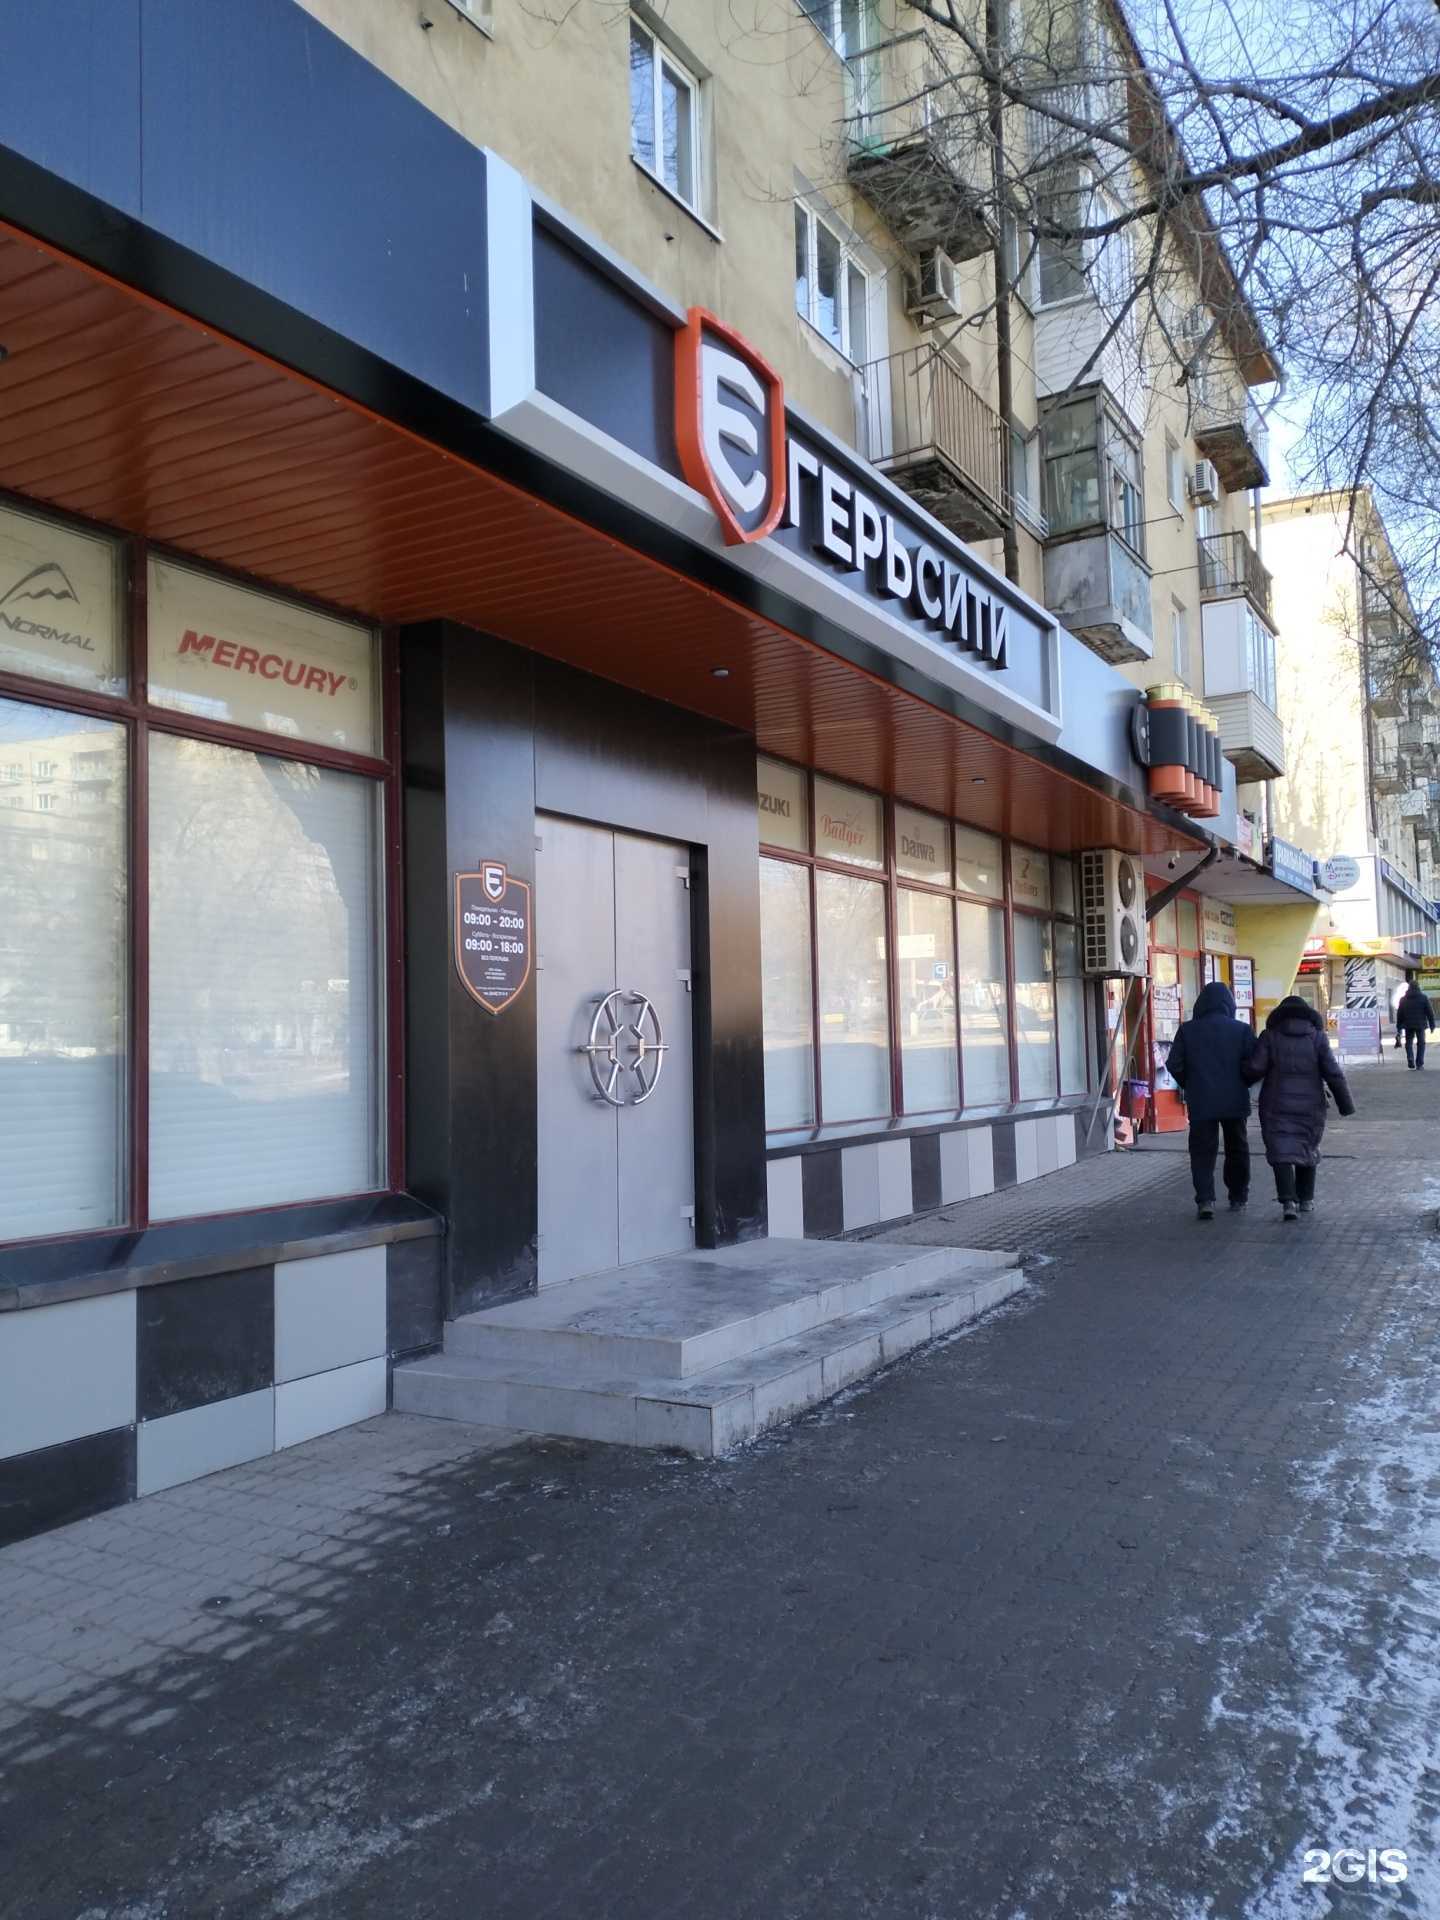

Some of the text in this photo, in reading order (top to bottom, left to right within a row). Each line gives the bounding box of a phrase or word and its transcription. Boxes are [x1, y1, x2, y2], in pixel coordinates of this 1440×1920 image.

[0, 611, 96, 652] NORMAL
[178, 629, 347, 697] MERCURY
[464, 912, 491, 926] 09:00
[499, 915, 524, 929] 20:00
[465, 938, 493, 952] 09:00
[500, 941, 524, 954] 18:00
